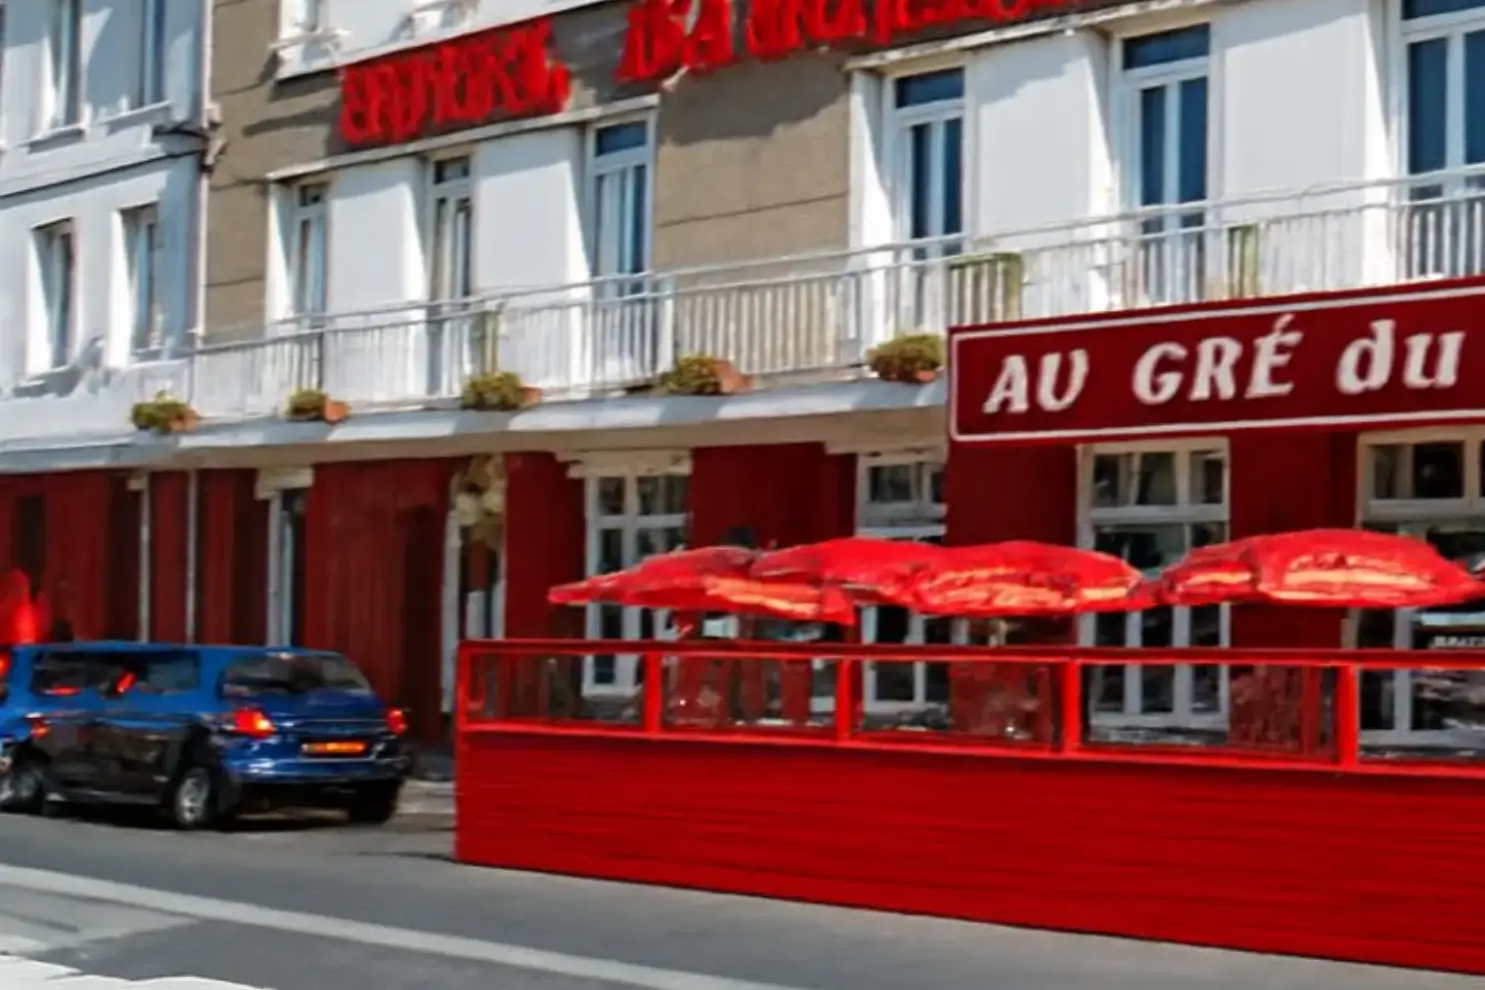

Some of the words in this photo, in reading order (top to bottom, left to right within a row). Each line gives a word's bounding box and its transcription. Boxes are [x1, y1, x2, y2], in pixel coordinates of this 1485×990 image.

[983, 347, 1090, 414] AU
[1131, 312, 1304, 406] GRÉ
[1335, 318, 1467, 395] du
